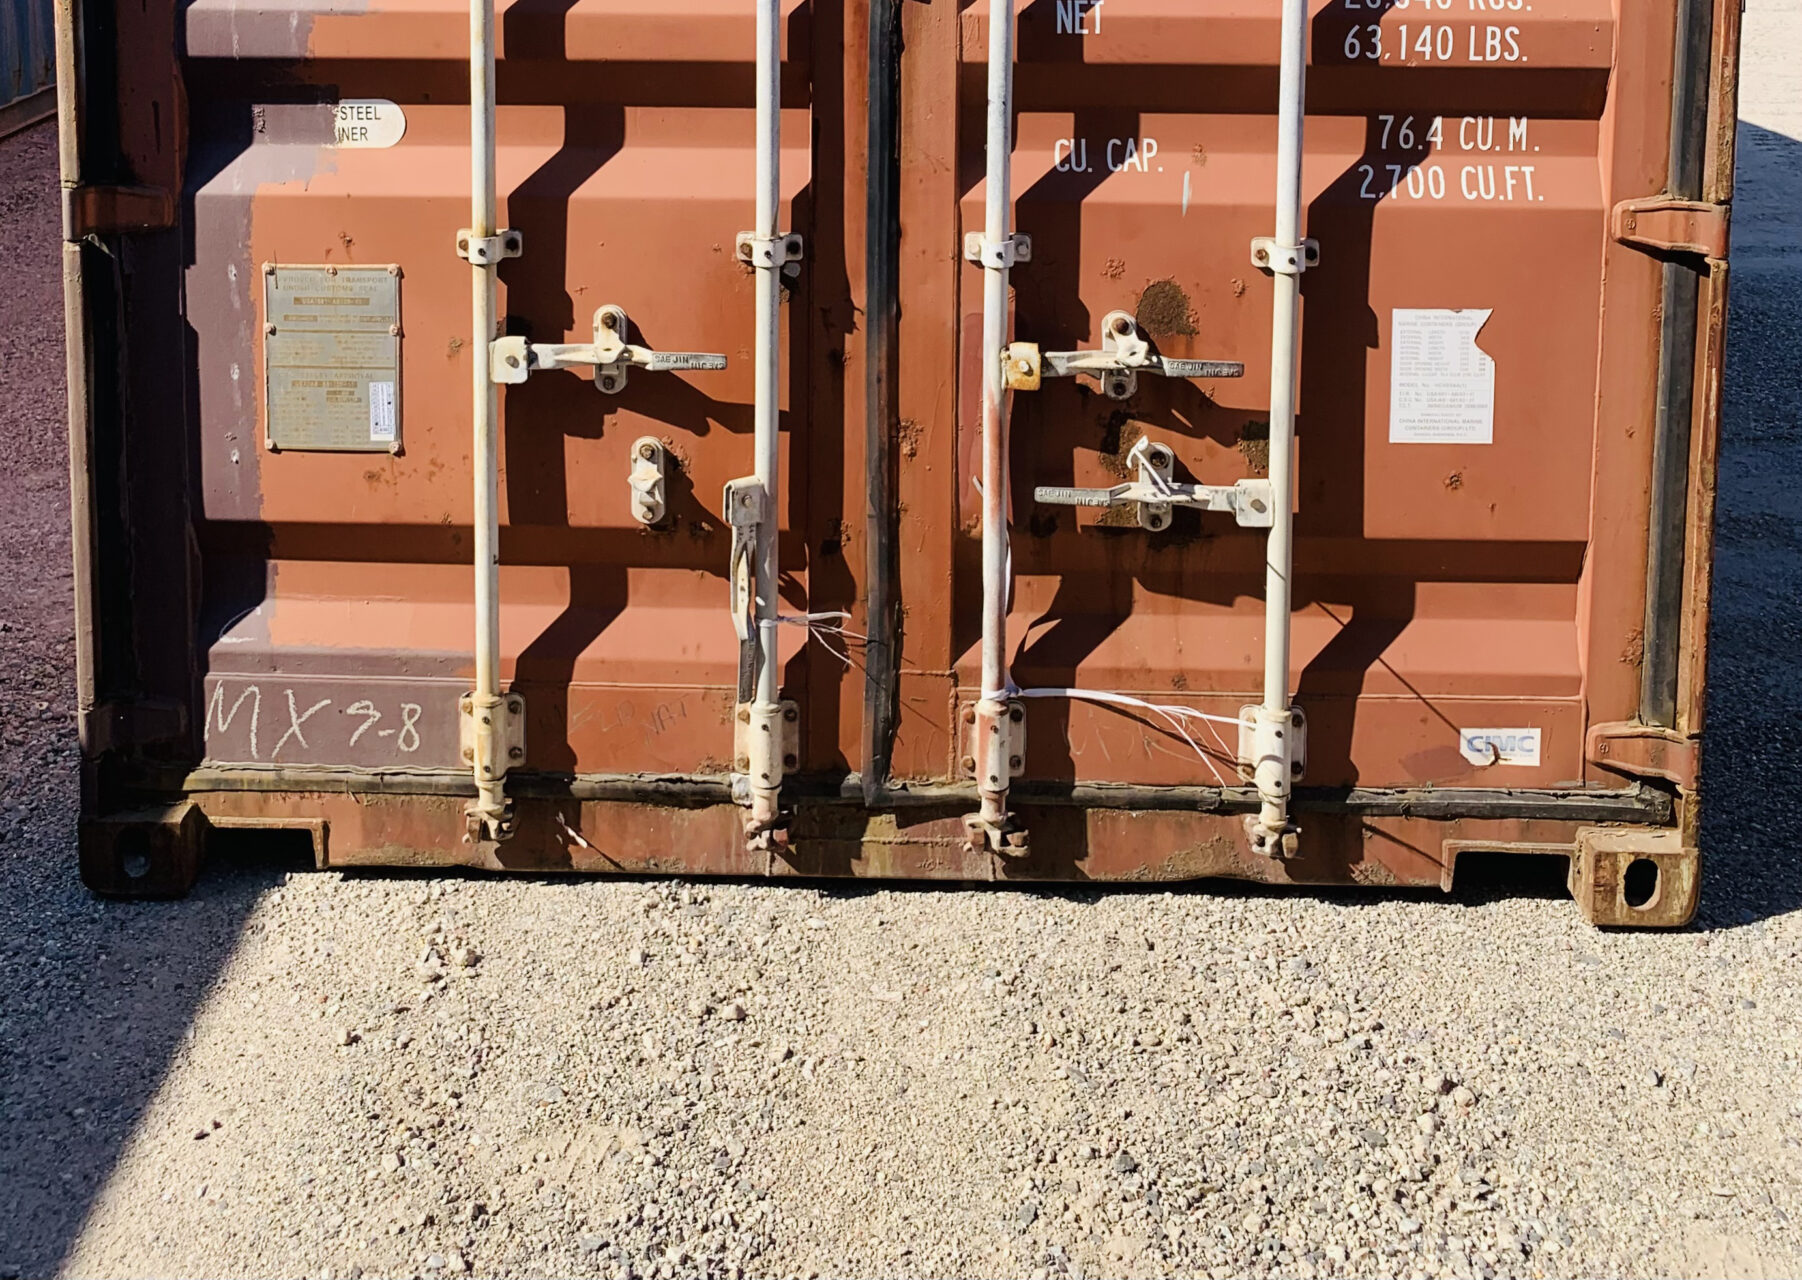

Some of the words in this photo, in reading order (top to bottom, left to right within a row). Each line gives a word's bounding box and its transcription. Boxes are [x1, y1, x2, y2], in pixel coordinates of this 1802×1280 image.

[1056, 0, 1104, 35] NET
[1344, 24, 1454, 61] 63,140
[1468, 25, 1528, 62] LBS.
[1378, 115, 1444, 151] 76.4
[1054, 138, 1093, 173] CU.
[1106, 137, 1163, 173] CAP.
[1358, 164, 1445, 200] 2,700
[1467, 735, 1535, 753] CIMC
